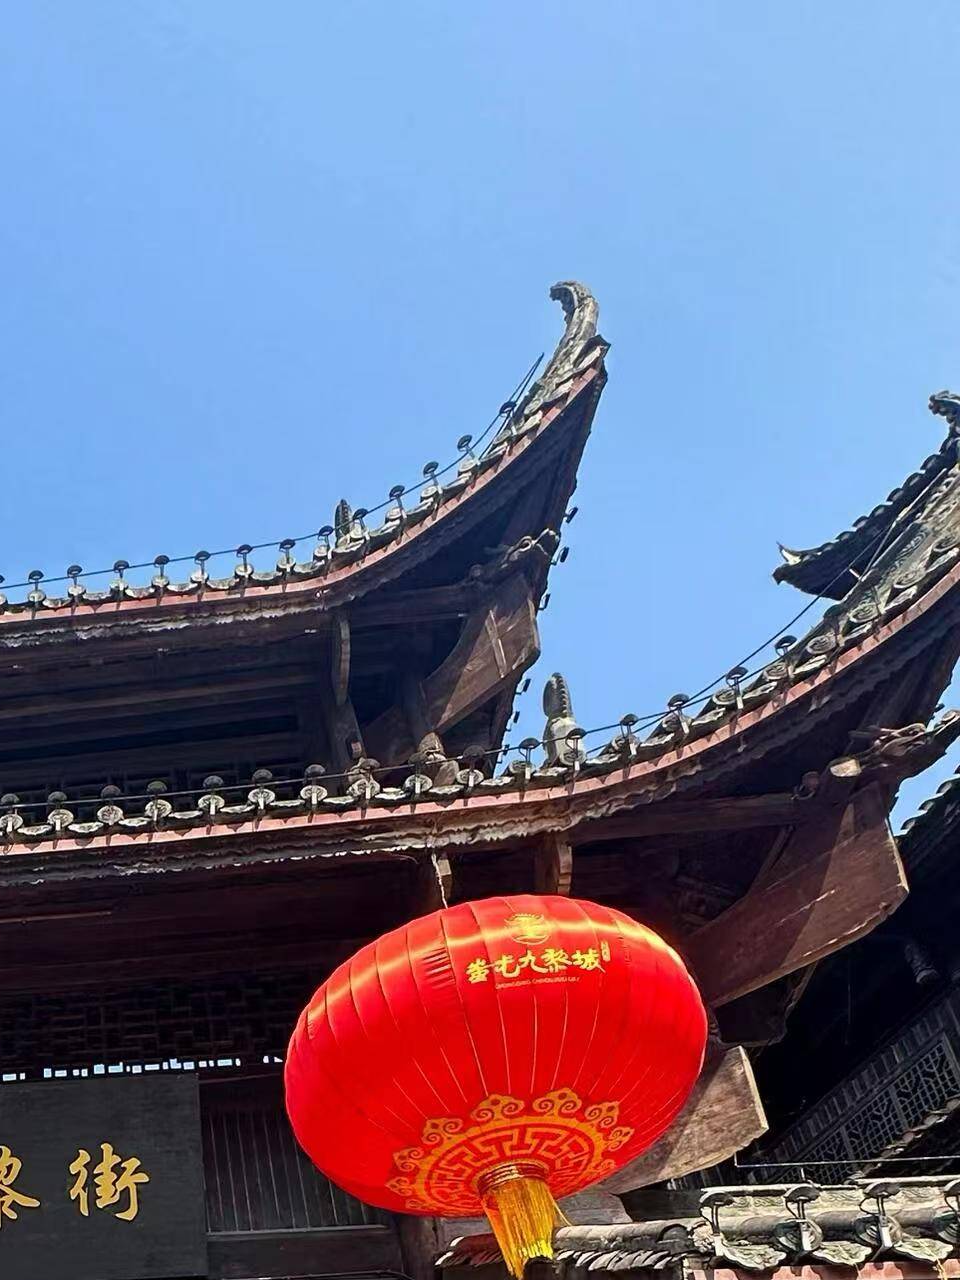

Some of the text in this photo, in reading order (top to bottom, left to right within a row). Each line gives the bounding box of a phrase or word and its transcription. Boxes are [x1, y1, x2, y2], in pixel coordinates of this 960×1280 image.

[465, 948, 605, 984] 蚩尤九黎城
